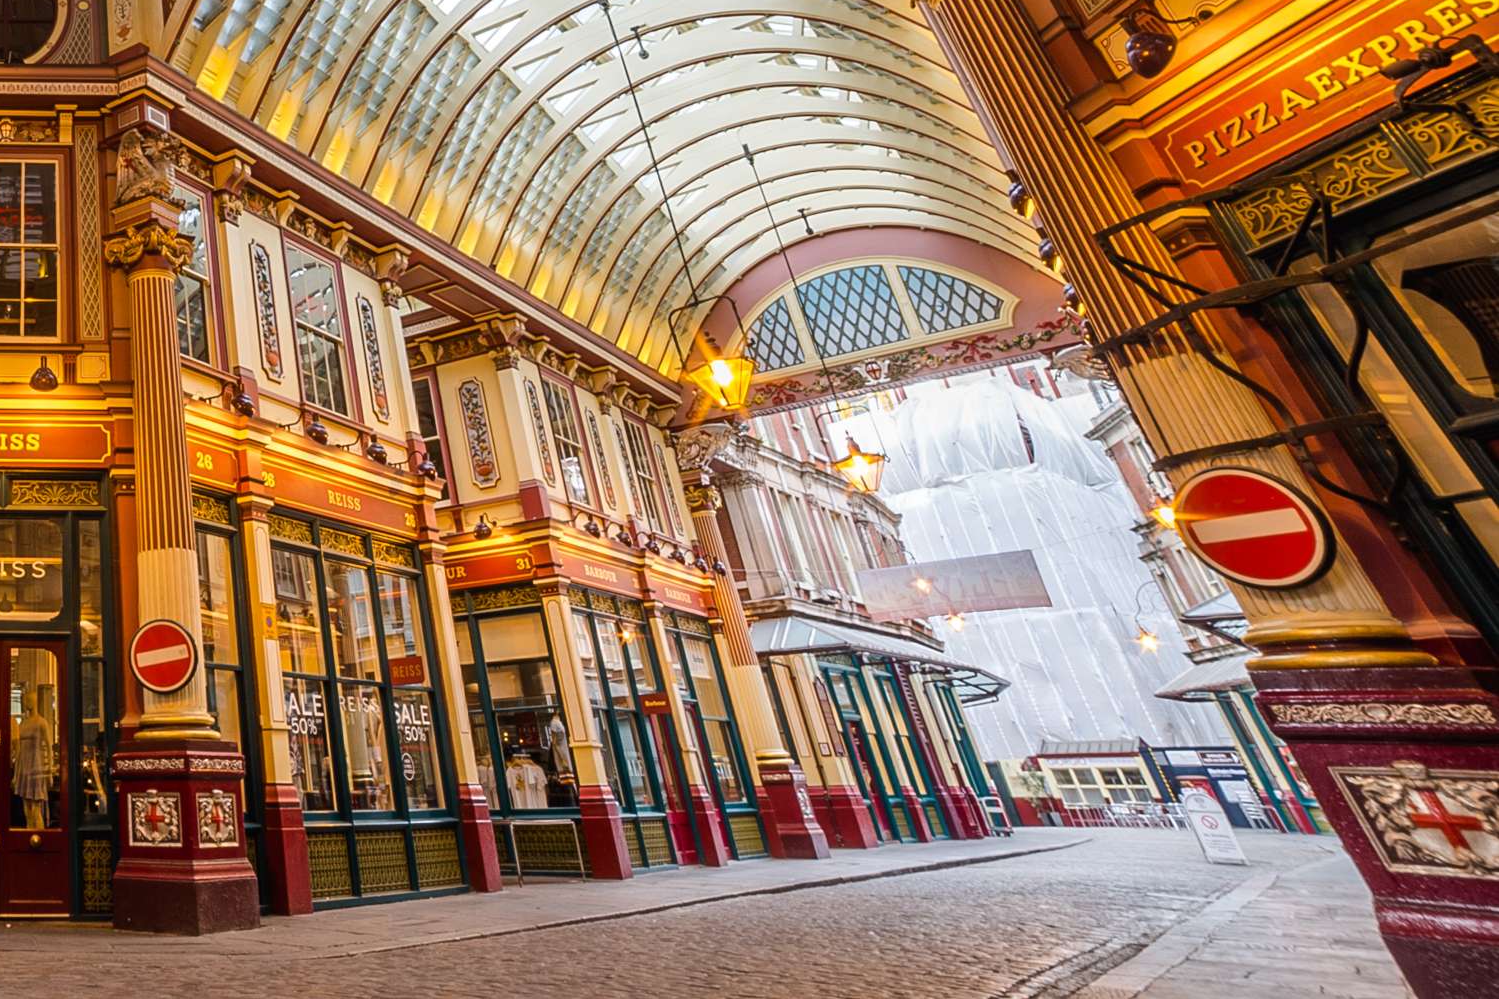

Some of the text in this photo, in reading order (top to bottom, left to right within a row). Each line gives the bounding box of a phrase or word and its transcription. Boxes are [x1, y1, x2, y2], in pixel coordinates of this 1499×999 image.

[195, 451, 213, 471] 26
[261, 471, 276, 488] 26
[327, 489, 362, 512] REISS
[515, 557, 532, 571] 31
[391, 663, 421, 679] REISS
[288, 691, 325, 717] ALE
